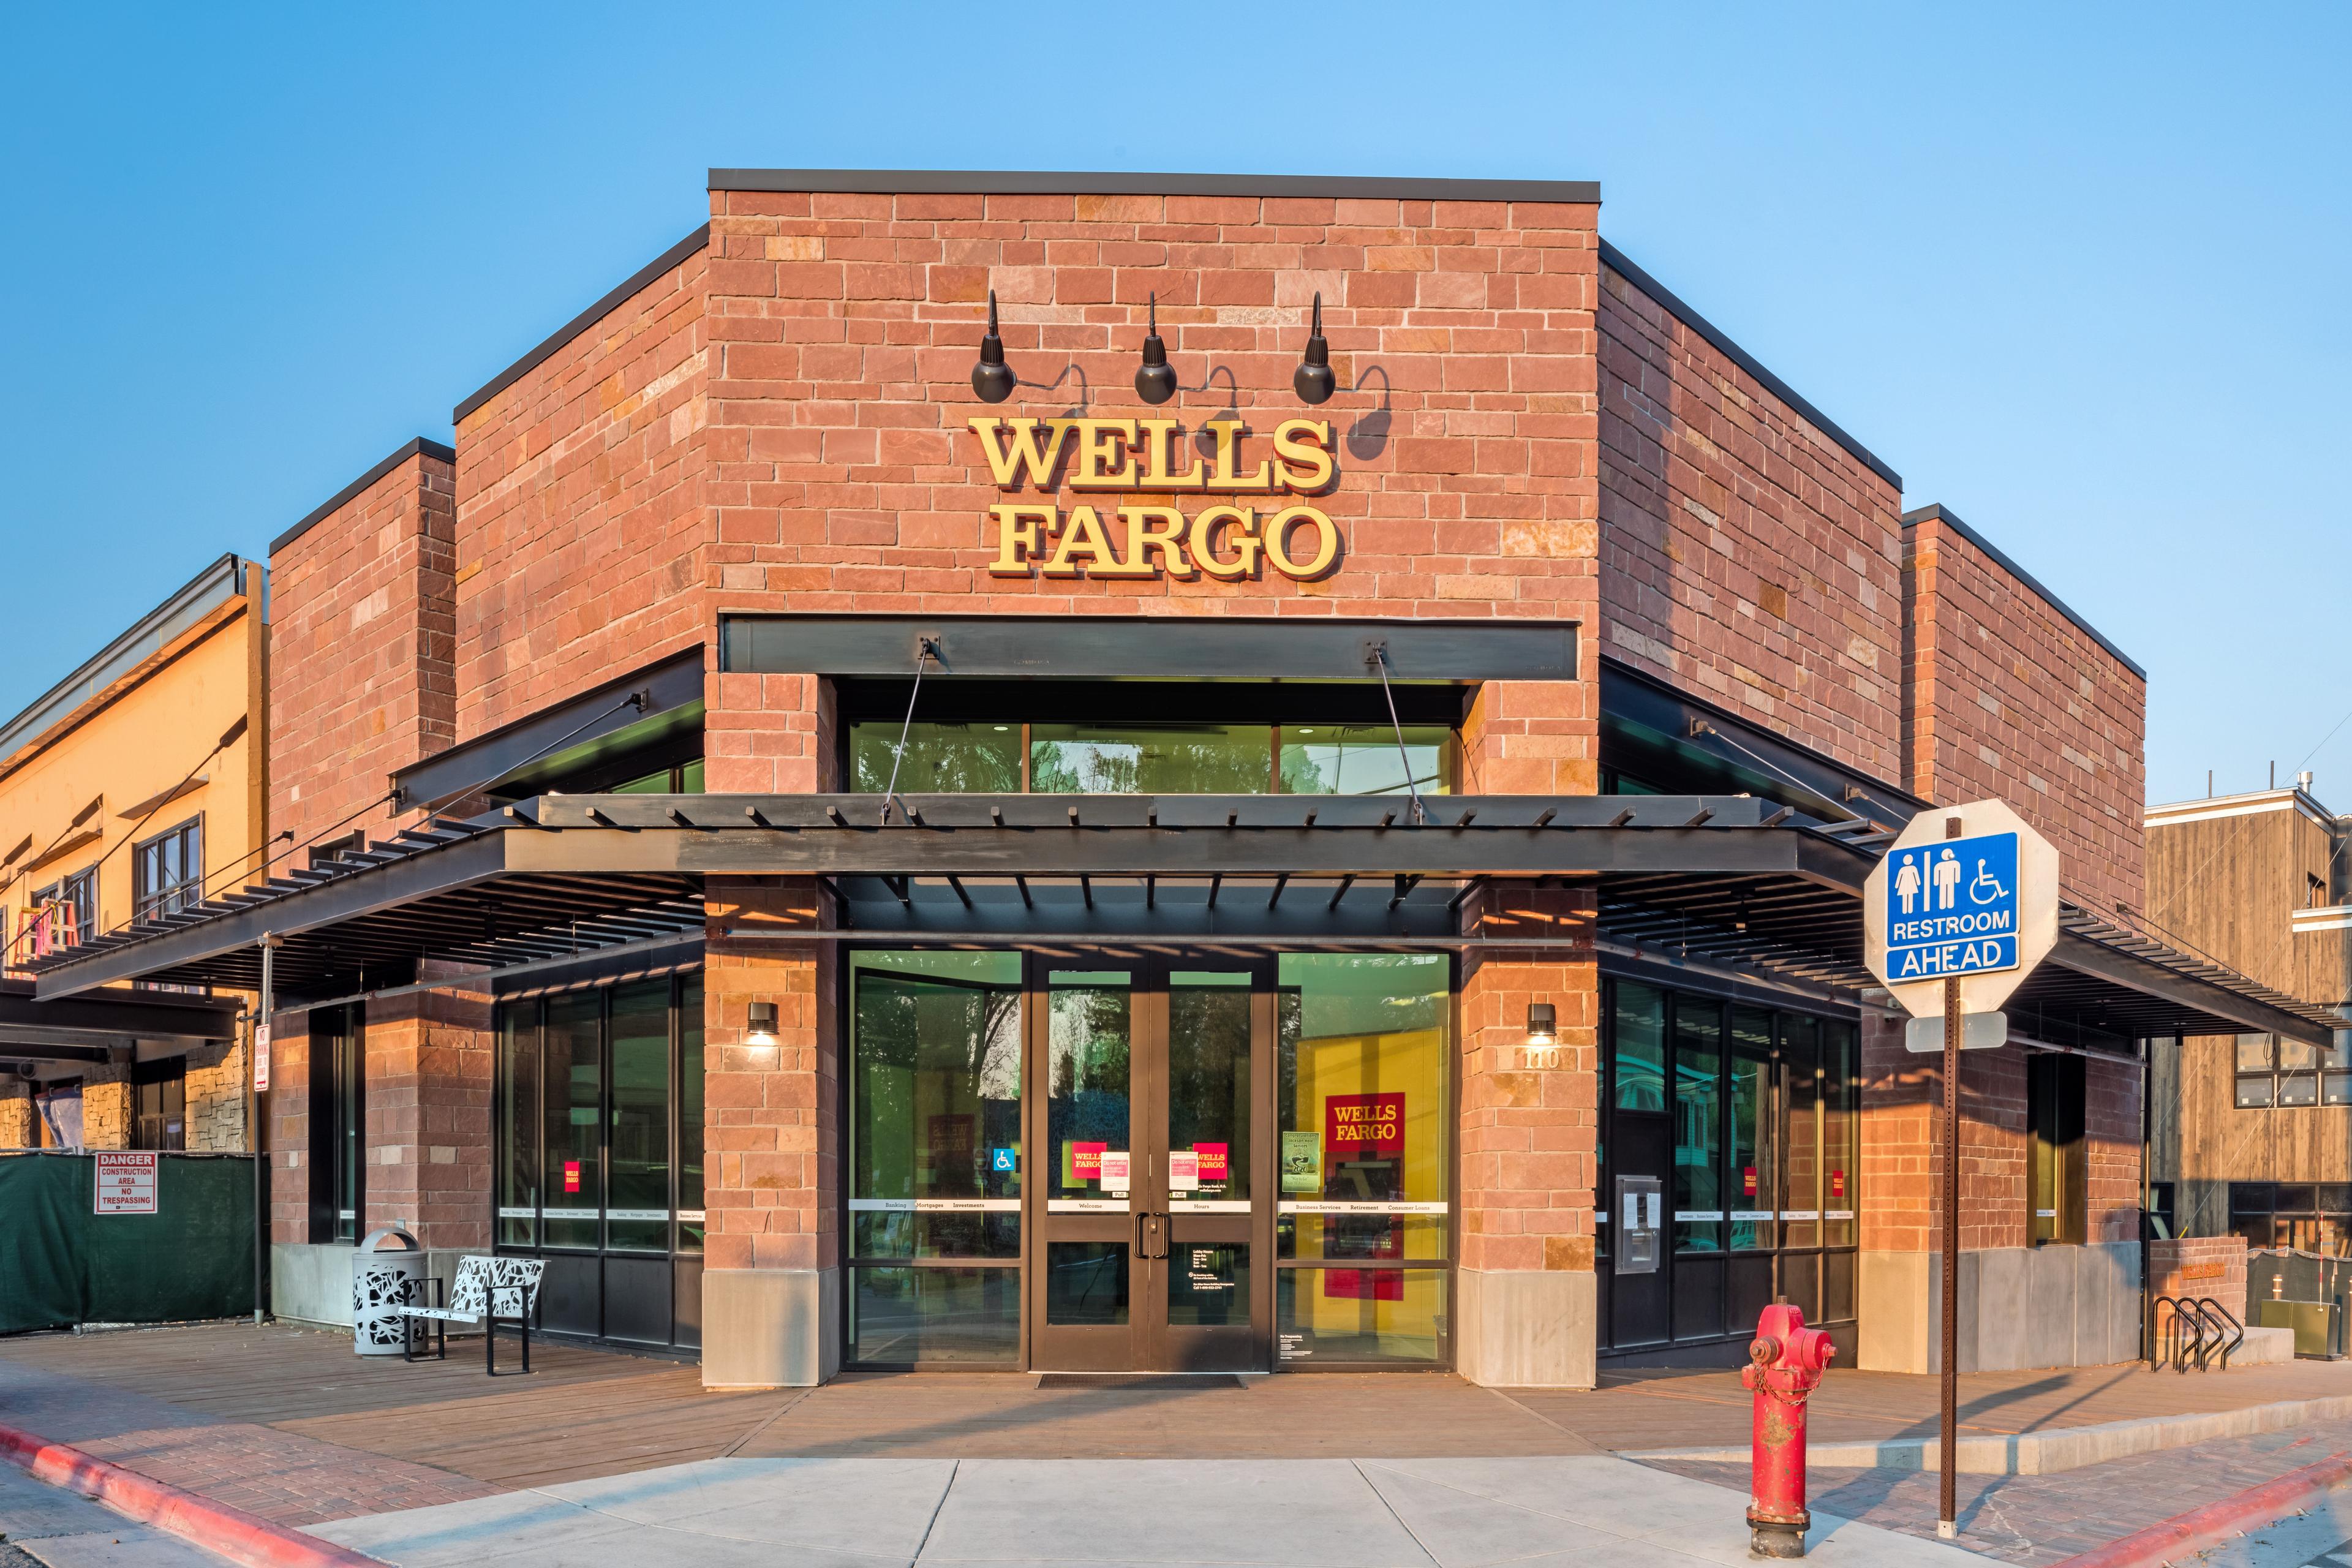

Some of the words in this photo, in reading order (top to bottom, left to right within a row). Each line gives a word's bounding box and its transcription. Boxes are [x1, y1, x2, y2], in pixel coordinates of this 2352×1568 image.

[967, 417, 1336, 492] WELLS
[989, 503, 1338, 581] FARGO
[1893, 910, 2010, 941] RESTROOM
[1900, 941, 2002, 976] AHEAD
[259, 1030, 265, 1041] NO
[256, 1044, 268, 1056] PARKING
[1525, 1048, 1559, 1069] 110
[1334, 1105, 1396, 1121] WELLS
[1336, 1124, 1396, 1140] FARGO
[100, 1155, 152, 1164] DANGER
[2181, 1264, 2203, 1280] WELLS
[2204, 1262, 2225, 1278] FARGO
